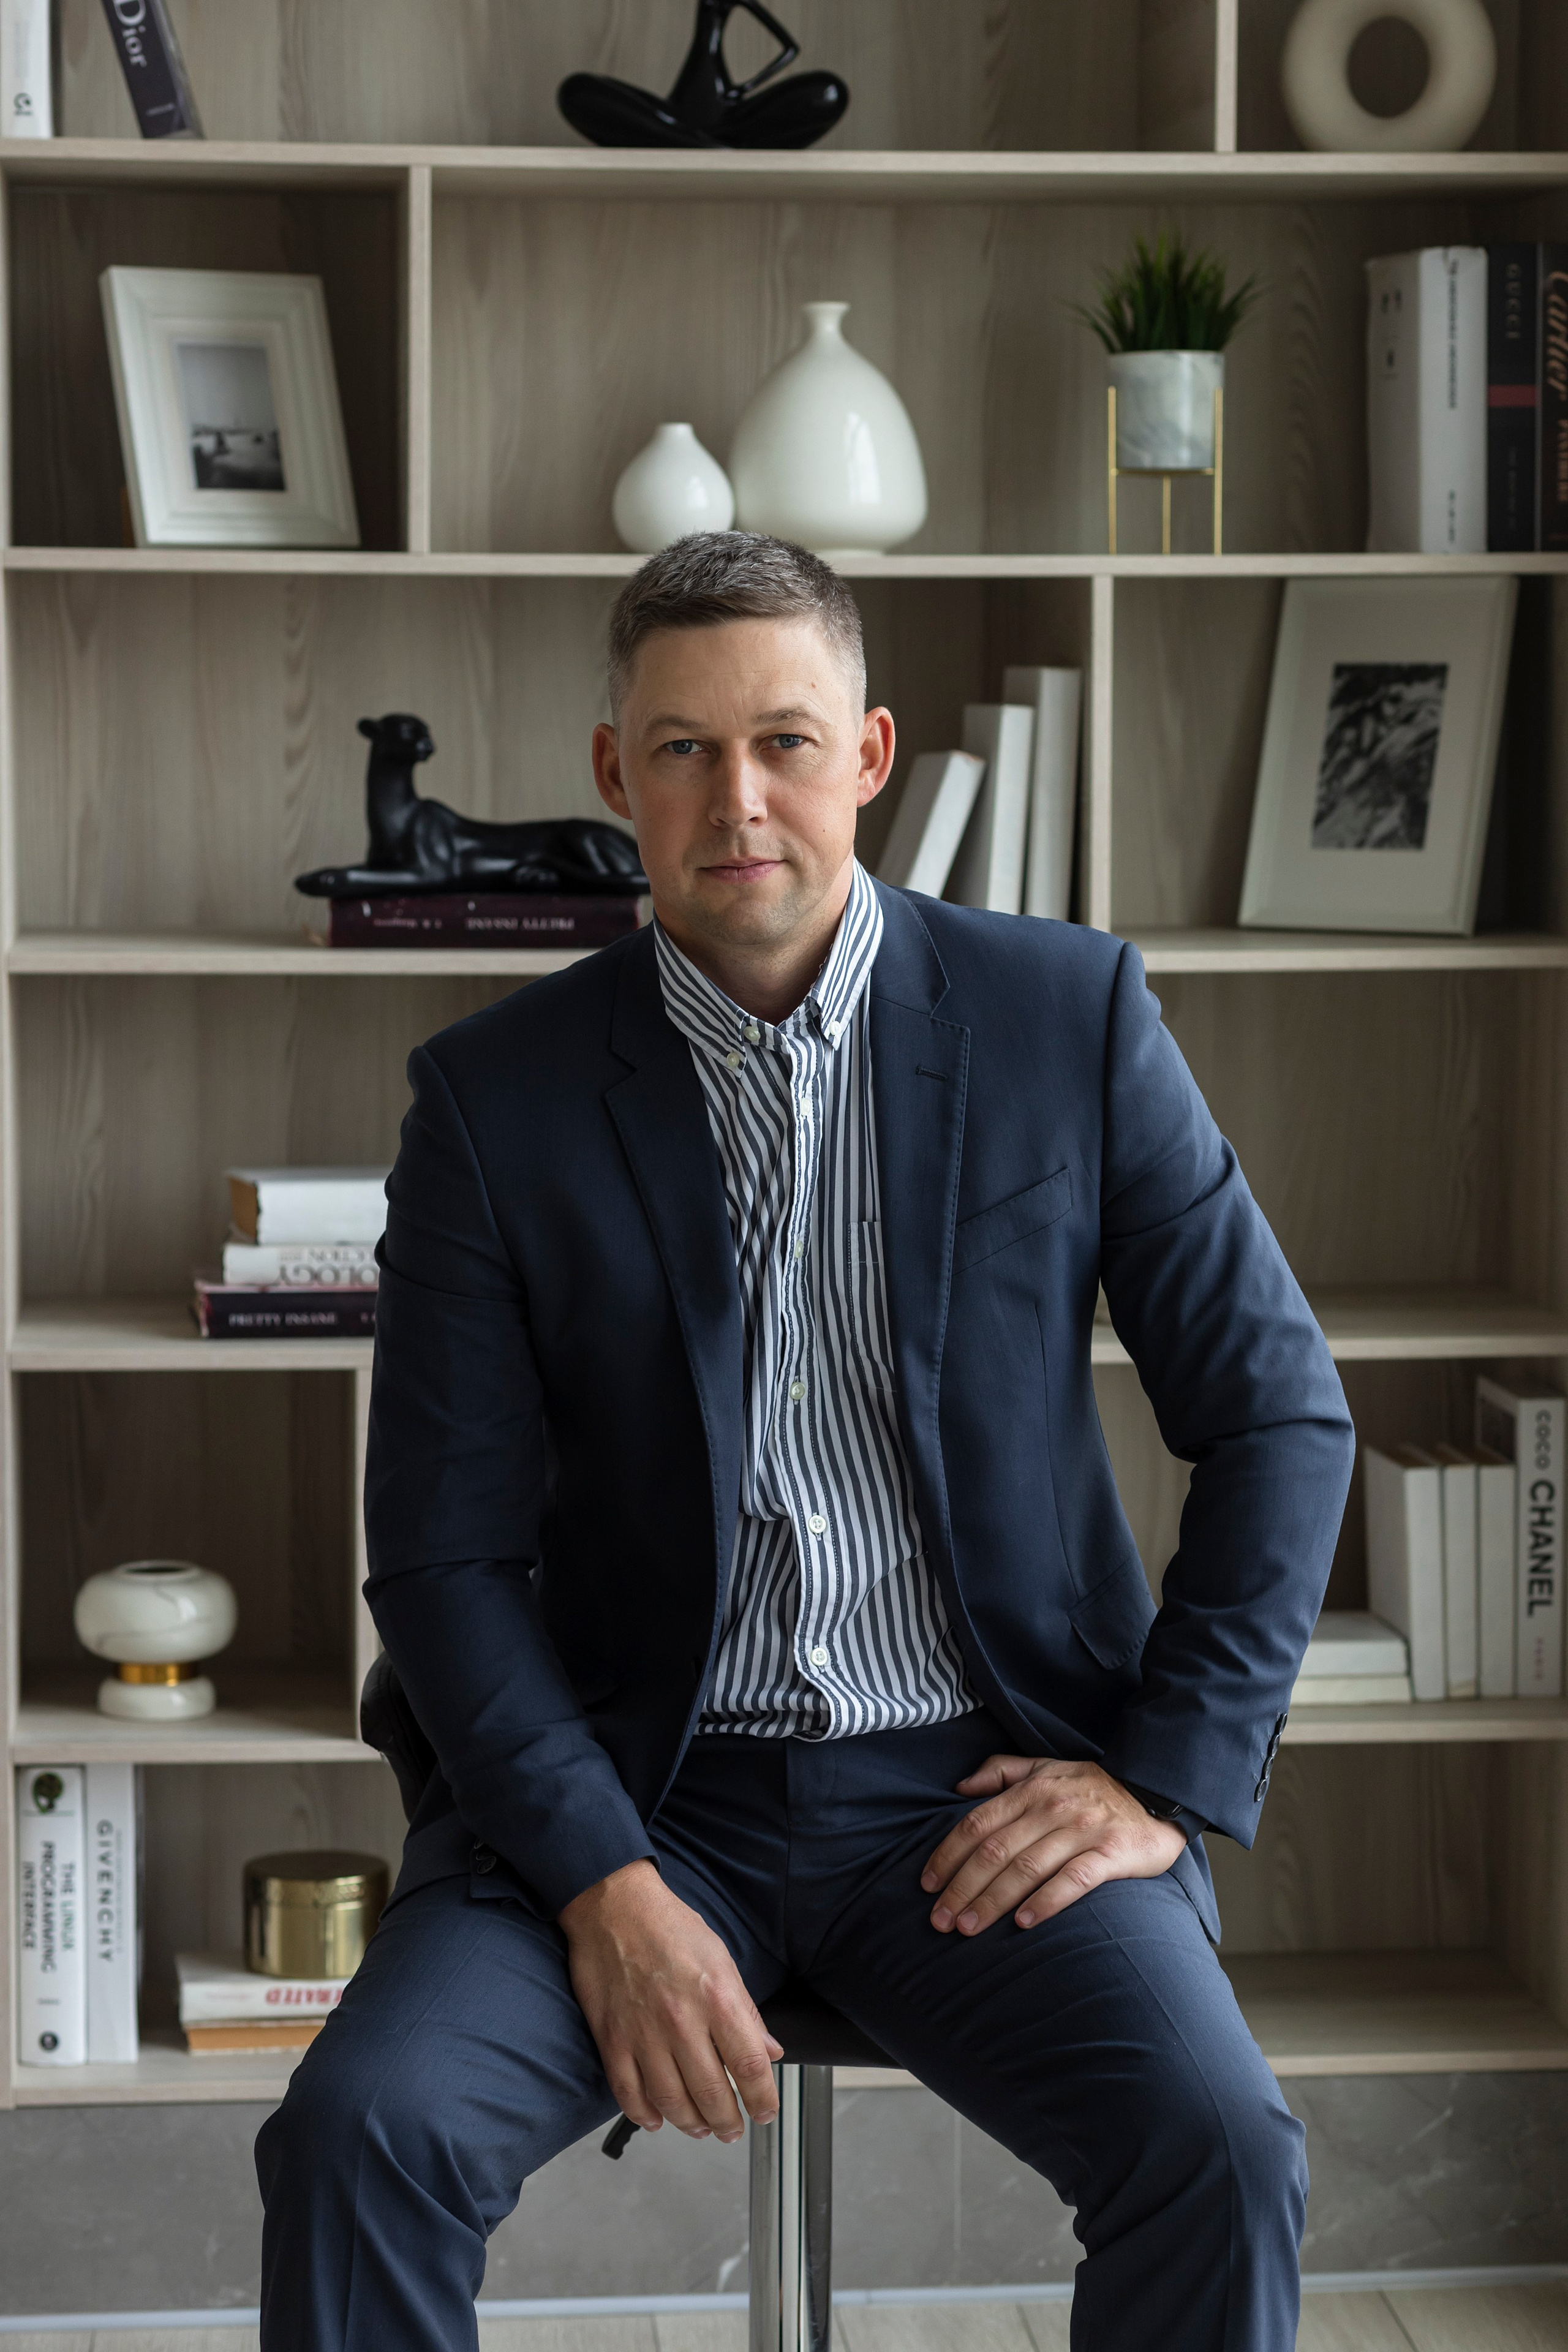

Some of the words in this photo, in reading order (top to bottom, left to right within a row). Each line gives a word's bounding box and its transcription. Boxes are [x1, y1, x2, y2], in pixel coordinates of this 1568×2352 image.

[113, 0, 147, 67] Dior
[1505, 263, 1521, 340] GUCCI
[1535, 1409, 1550, 1471] COCO
[1527, 1480, 1555, 1616] CHANEL
[97, 1819, 113, 1963] GIVENCHY
